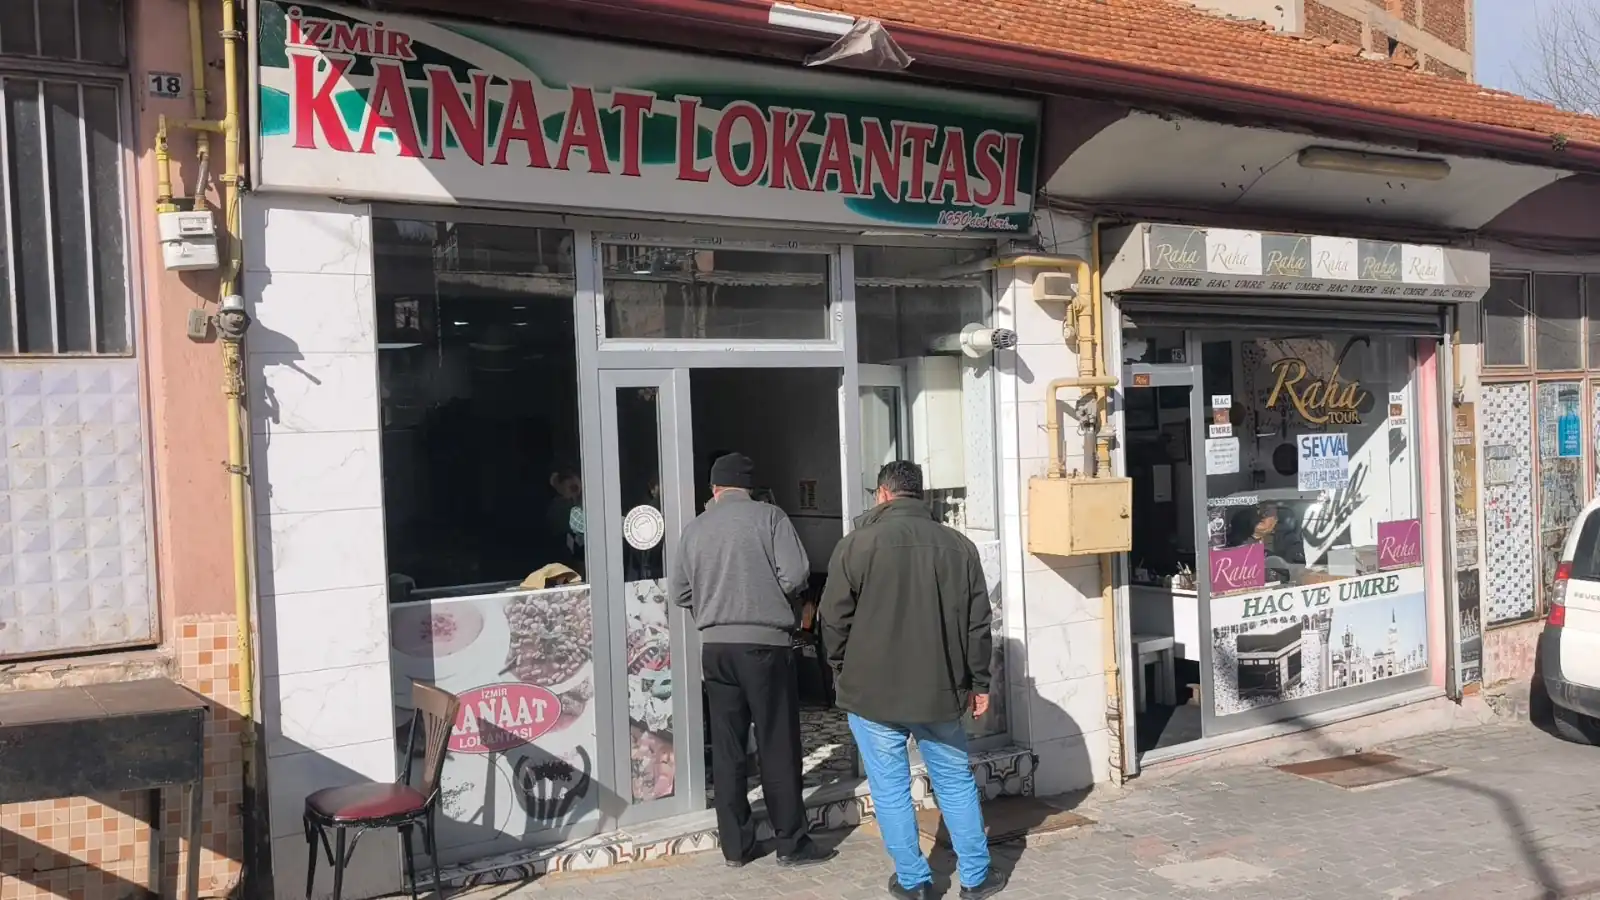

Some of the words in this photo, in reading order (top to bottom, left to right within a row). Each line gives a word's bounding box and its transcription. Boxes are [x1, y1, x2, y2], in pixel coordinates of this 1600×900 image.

[286, 8, 416, 60] İZMİR
[151, 75, 181, 94] 18
[290, 53, 654, 177] KANAAT
[676, 98, 1023, 207] LOKANTASI
[1155, 229, 1203, 270] Raha
[1211, 234, 1252, 270] Raha
[1266, 237, 1307, 277] Raha
[1316, 241, 1352, 276] Raha
[1362, 244, 1398, 280] Raha
[1140, 276, 1165, 285] HAC
[1169, 277, 1202, 287] UMRE
[1206, 279, 1230, 288] HAC
[1234, 280, 1265, 289] UMRE
[1269, 281, 1290, 290] HAC
[1294, 282, 1324, 291] UMRE
[1326, 284, 1348, 292] HAC
[1351, 285, 1378, 294] UMRE
[1381, 287, 1400, 295] HAC
[1403, 288, 1428, 296] UMRE
[1265, 336, 1370, 424] Raha
[1328, 411, 1361, 425] TOUR
[1380, 520, 1420, 563] Raha
[1213, 544, 1261, 587] Raha
[1242, 591, 1295, 618] HAC
[1301, 586, 1331, 609] VE
[1339, 574, 1400, 602] UMRE
[459, 727, 533, 748] LOKANTASI
